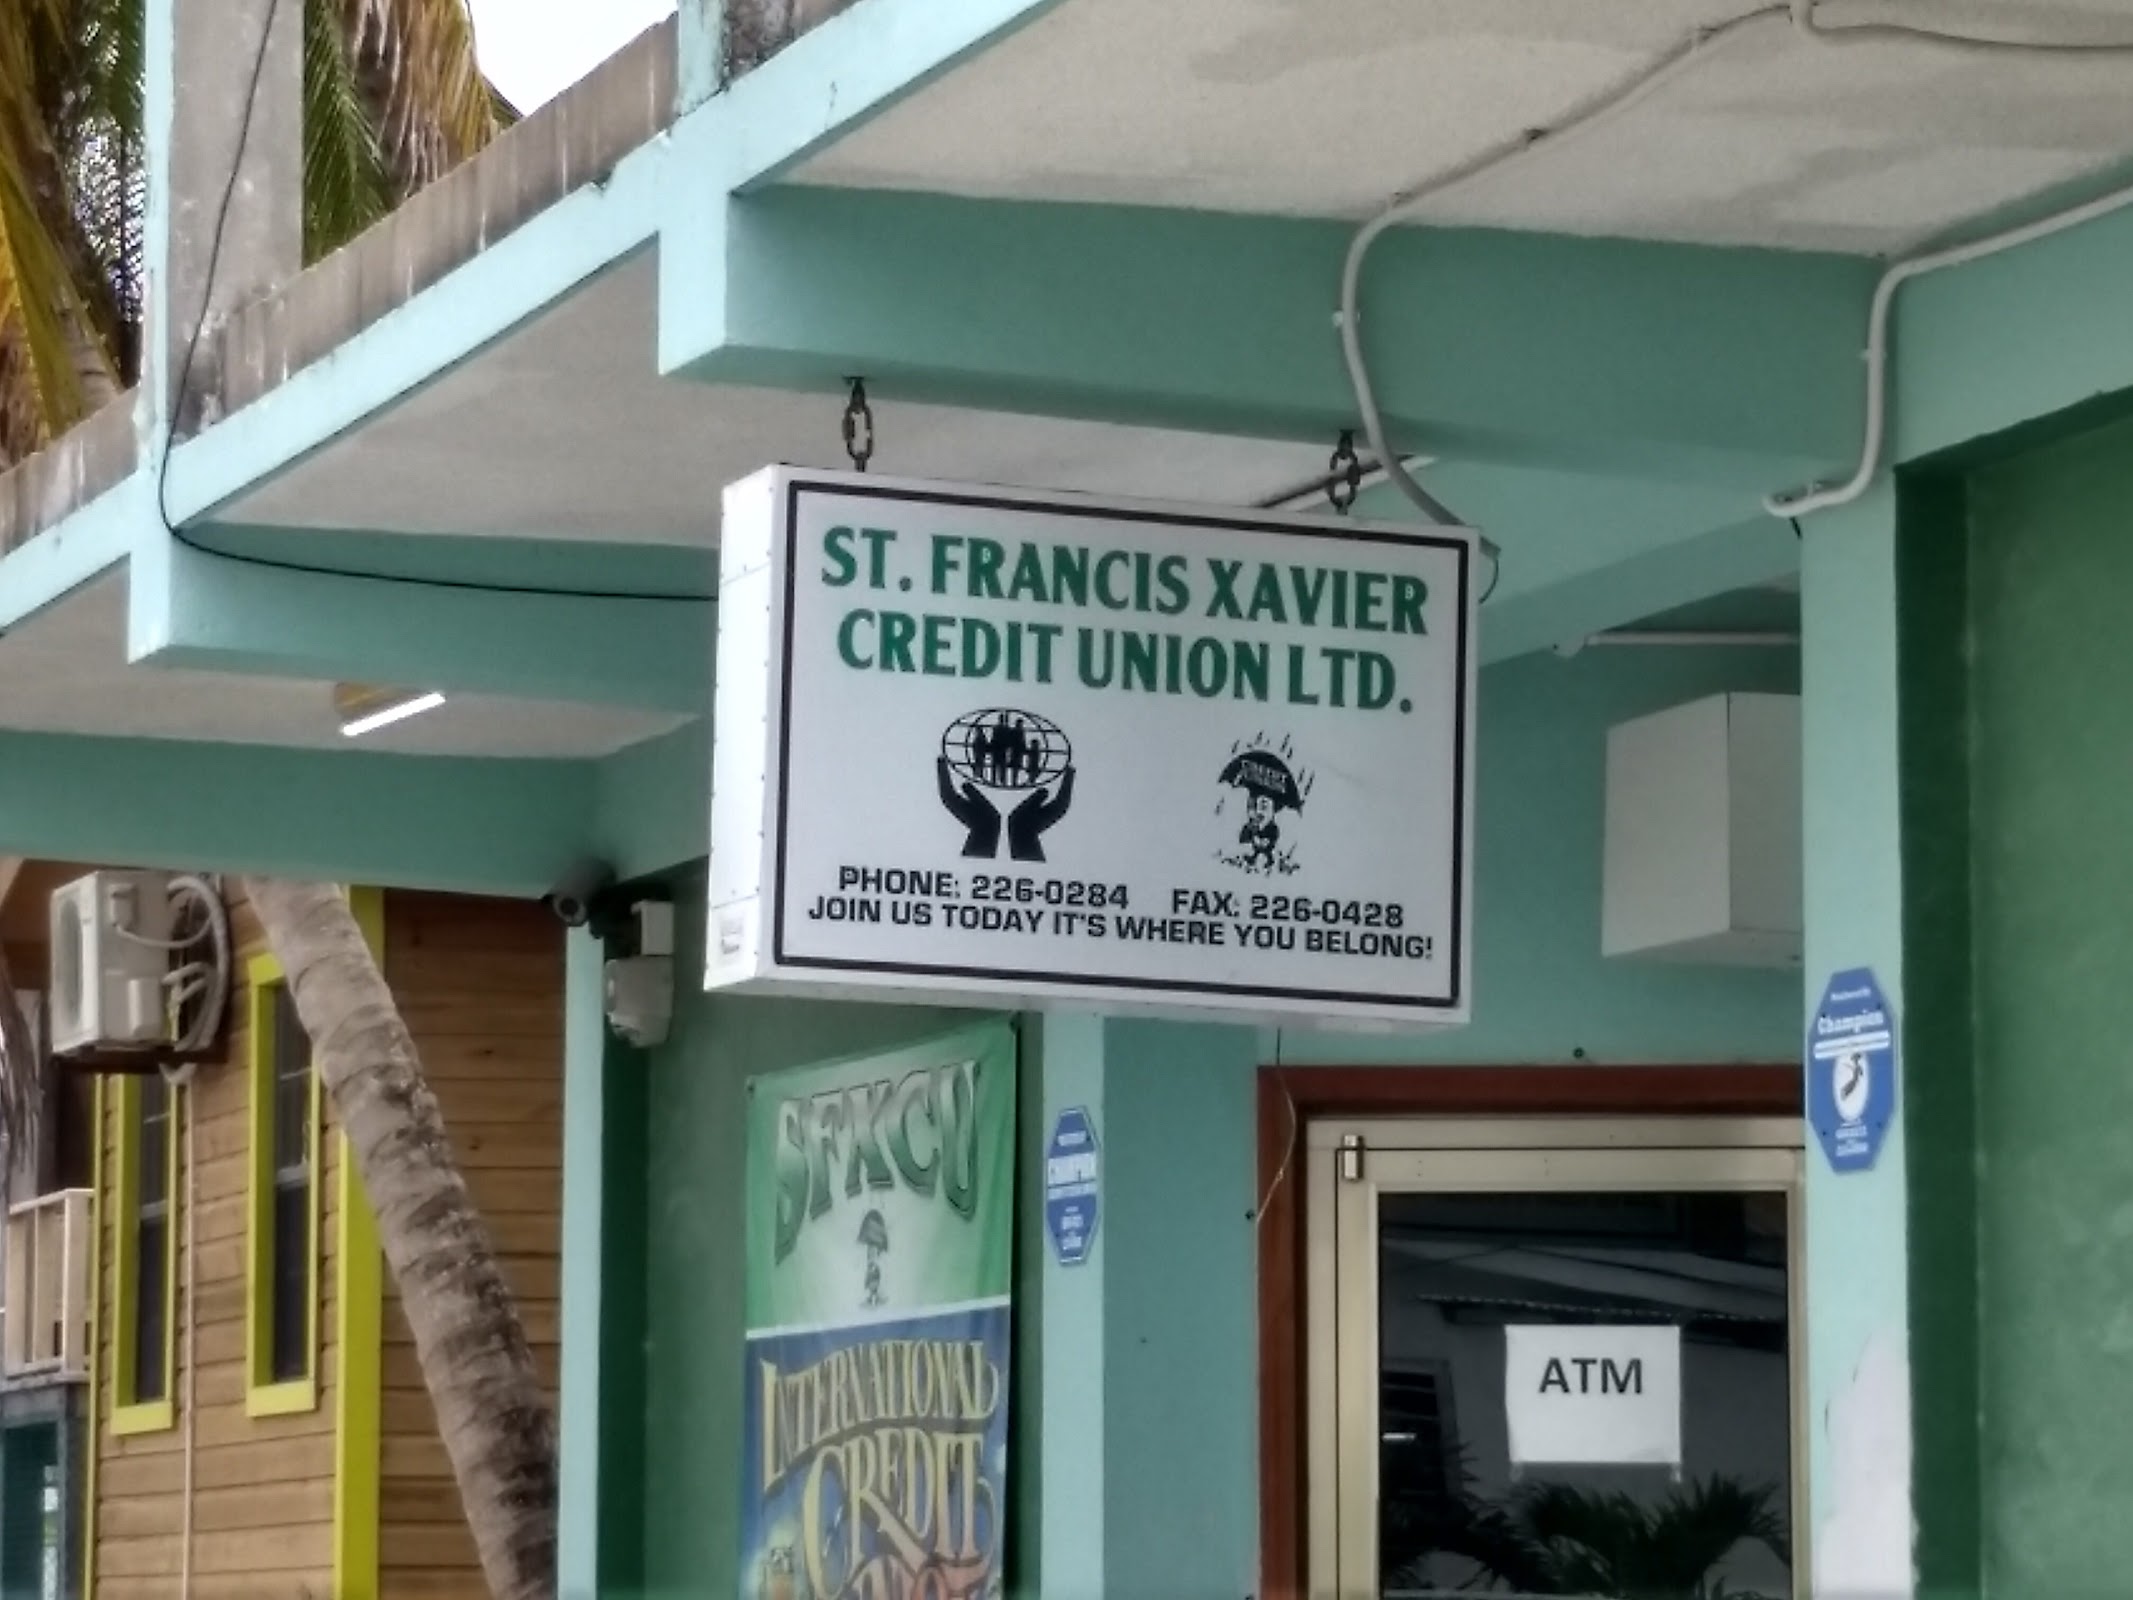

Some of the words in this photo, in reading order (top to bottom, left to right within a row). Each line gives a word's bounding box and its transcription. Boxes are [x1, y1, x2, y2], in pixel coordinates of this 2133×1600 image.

[821, 525, 913, 592] ST.
[931, 534, 1190, 615] FRANCIS
[1205, 558, 1429, 636] XAVIER
[837, 608, 1064, 684] CREDIT
[1077, 627, 1269, 703] UNION
[1287, 644, 1413, 714] LTD.
[838, 864, 961, 899] PHONE:
[971, 872, 1130, 910] 226-0284
[1171, 887, 1240, 918] FAX:
[1250, 893, 1404, 929] 226-0428
[808, 896, 881, 923] JOIN
[891, 900, 932, 926] US
[942, 903, 1043, 934] TODAY
[1053, 910, 1107, 938] IT'S
[1115, 915, 1225, 946] WHERE
[1233, 921, 1296, 952] YOU
[1305, 927, 1433, 961] BELONG!
[1817, 1010, 1884, 1035] Champion
[1538, 1357, 1643, 1395] ATM
[759, 1338, 999, 1493] INTERNATIONAL
[803, 1426, 987, 1600] CREDIT
